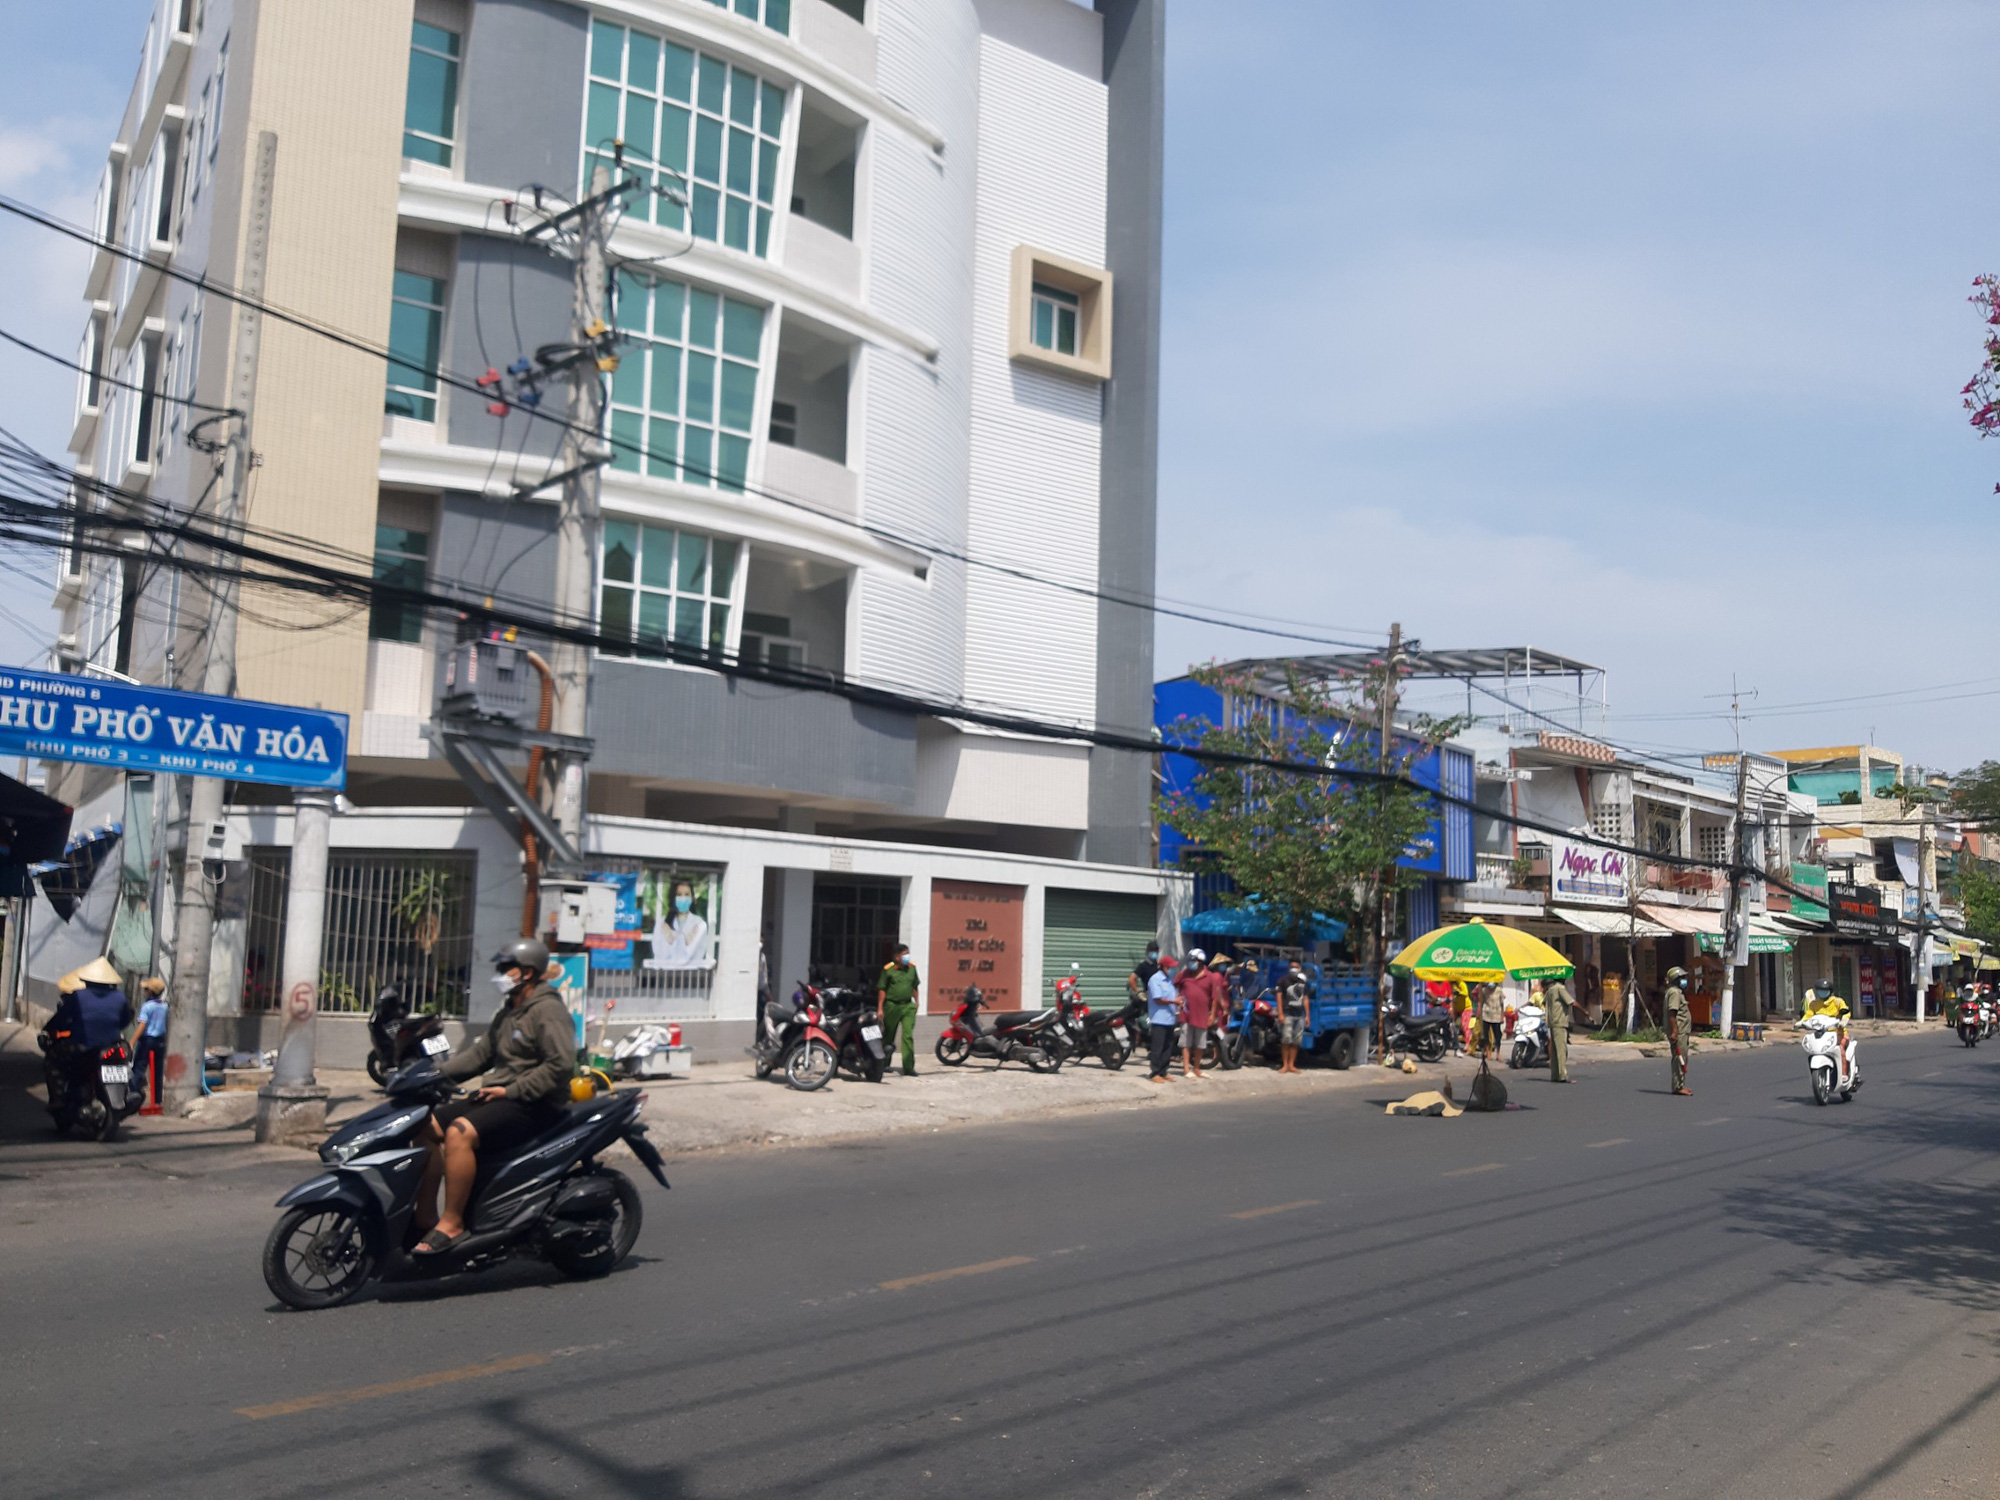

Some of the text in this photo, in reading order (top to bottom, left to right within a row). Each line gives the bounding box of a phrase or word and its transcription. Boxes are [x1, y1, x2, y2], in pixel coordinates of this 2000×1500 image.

[20, 678, 86, 699] PHƯỜNG
[90, 688, 101, 700] 8
[71, 704, 161, 742] PHỐ
[167, 712, 245, 753] VĂN
[255, 725, 330, 763] HÓA
[25, 740, 66, 755] KHU
[118, 749, 129, 762] 3
[160, 754, 197, 769] KHU
[243, 763, 255, 775] 4
